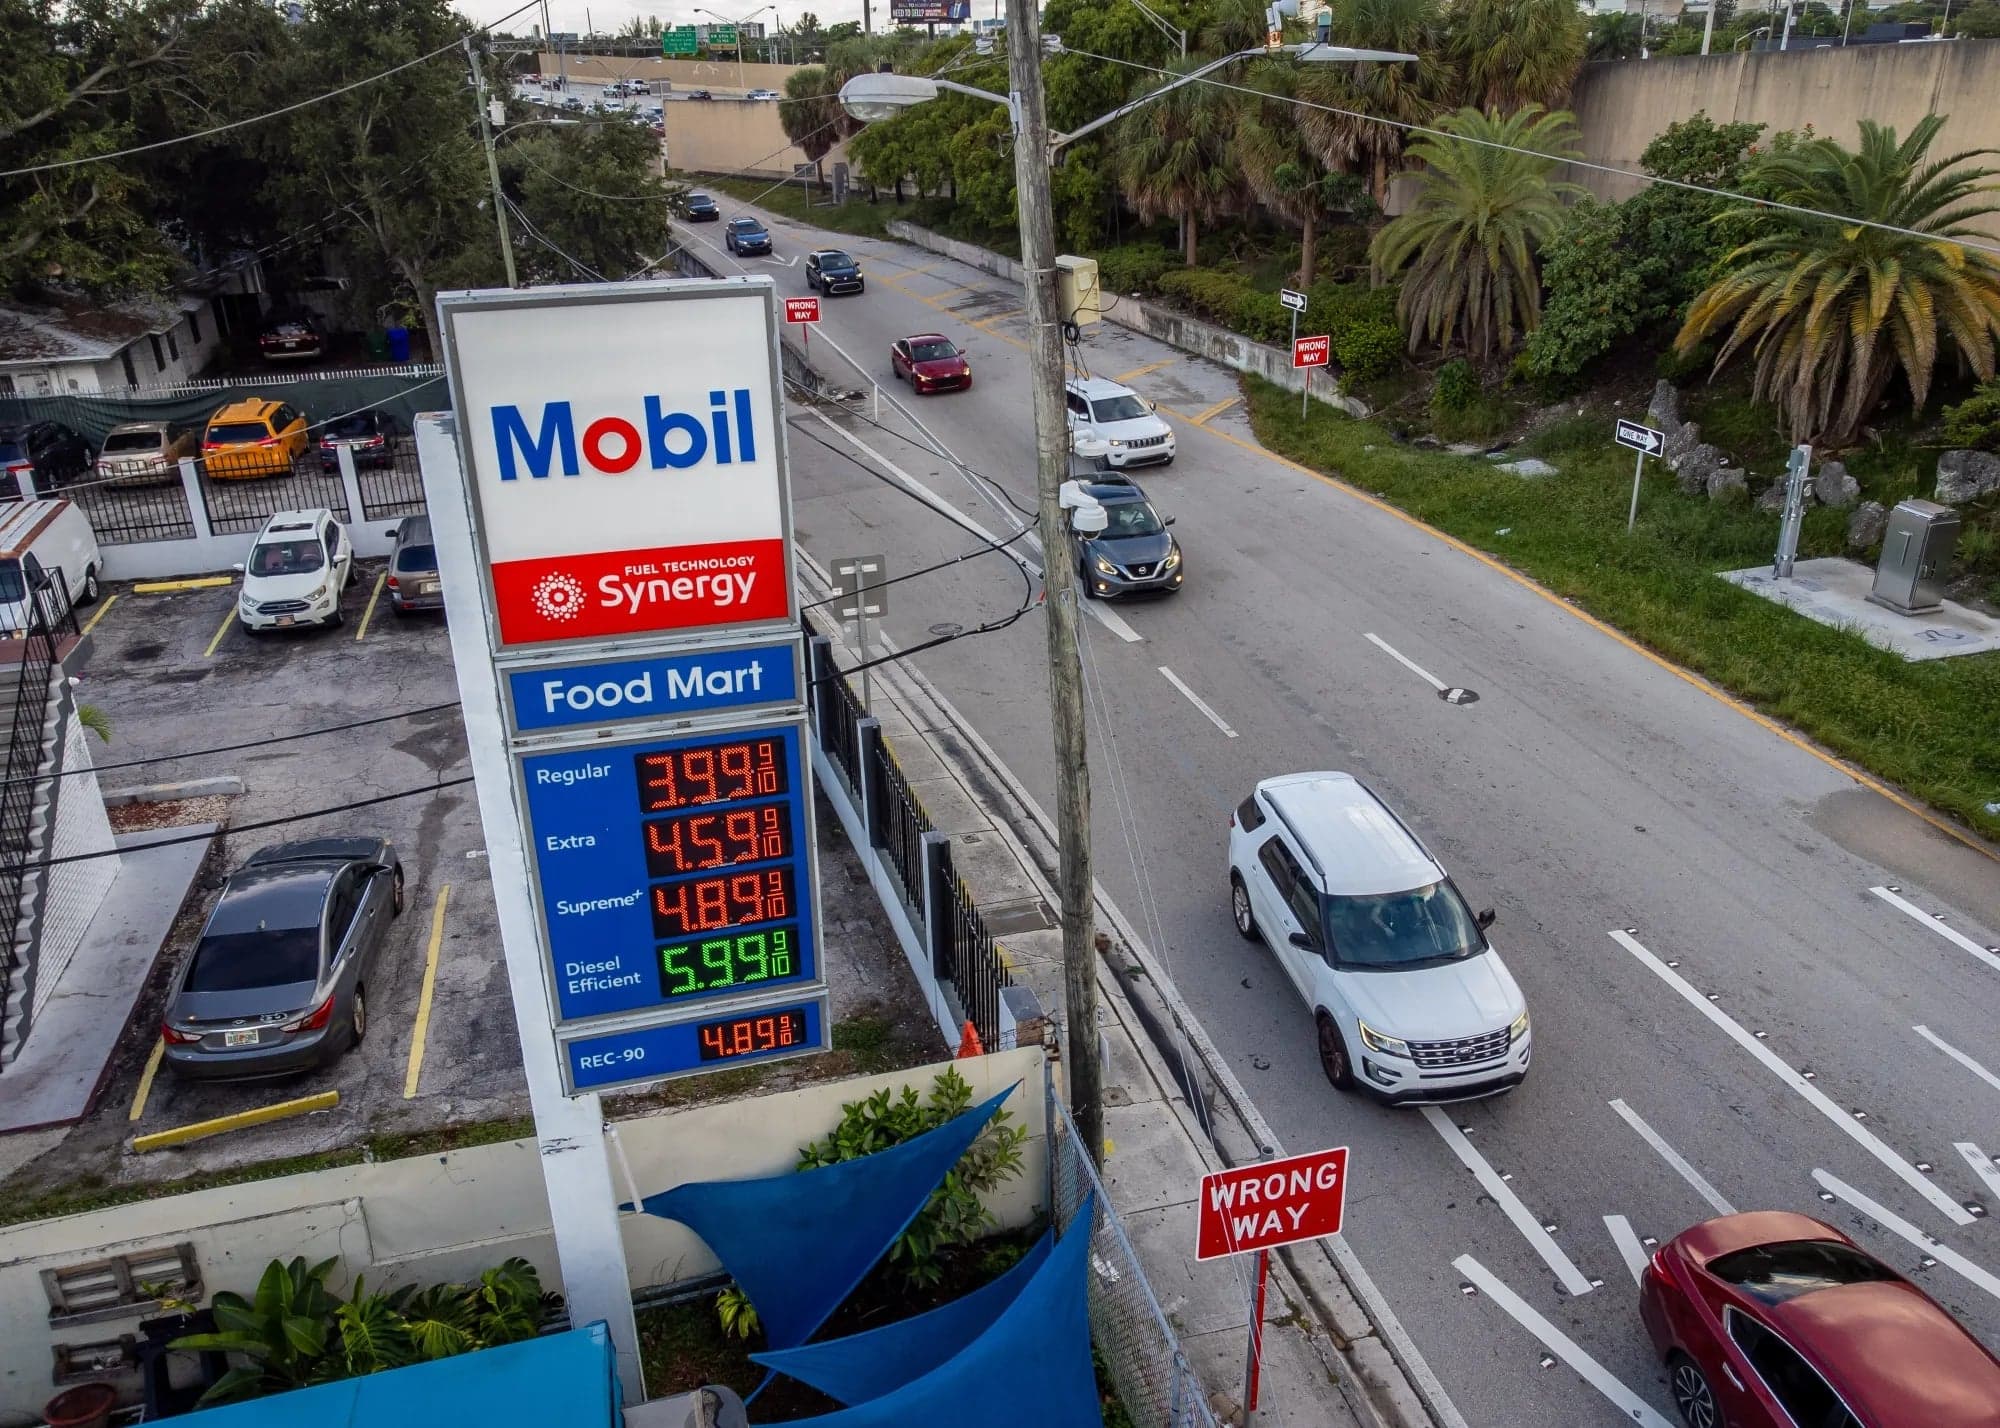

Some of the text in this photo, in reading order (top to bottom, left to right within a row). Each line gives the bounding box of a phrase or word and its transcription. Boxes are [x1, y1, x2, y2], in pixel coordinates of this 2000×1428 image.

[788, 301, 816, 310] WRONG
[794, 311, 811, 320] WAY
[1298, 340, 1326, 352] WRONG
[1302, 352, 1320, 363] WAY
[490, 388, 756, 481] Mobil
[624, 556, 755, 576] FUEL TECHNOLOGY
[598, 571, 756, 615] Synergy
[543, 660, 763, 713] Food Mart
[536, 763, 611, 786] Regular
[646, 745, 753, 809] 3.99
[546, 833, 596, 851] Extra
[649, 811, 759, 871] 4.59
[656, 874, 763, 932] 4.89
[565, 955, 621, 977] Diesel
[568, 971, 642, 994] Efficient
[663, 934, 768, 994] 5.99
[580, 1047, 645, 1070] REC-90
[703, 1018, 776, 1056] 4.89
[1210, 1162, 1337, 1212] WRONG
[1233, 1203, 1310, 1242] WAY
